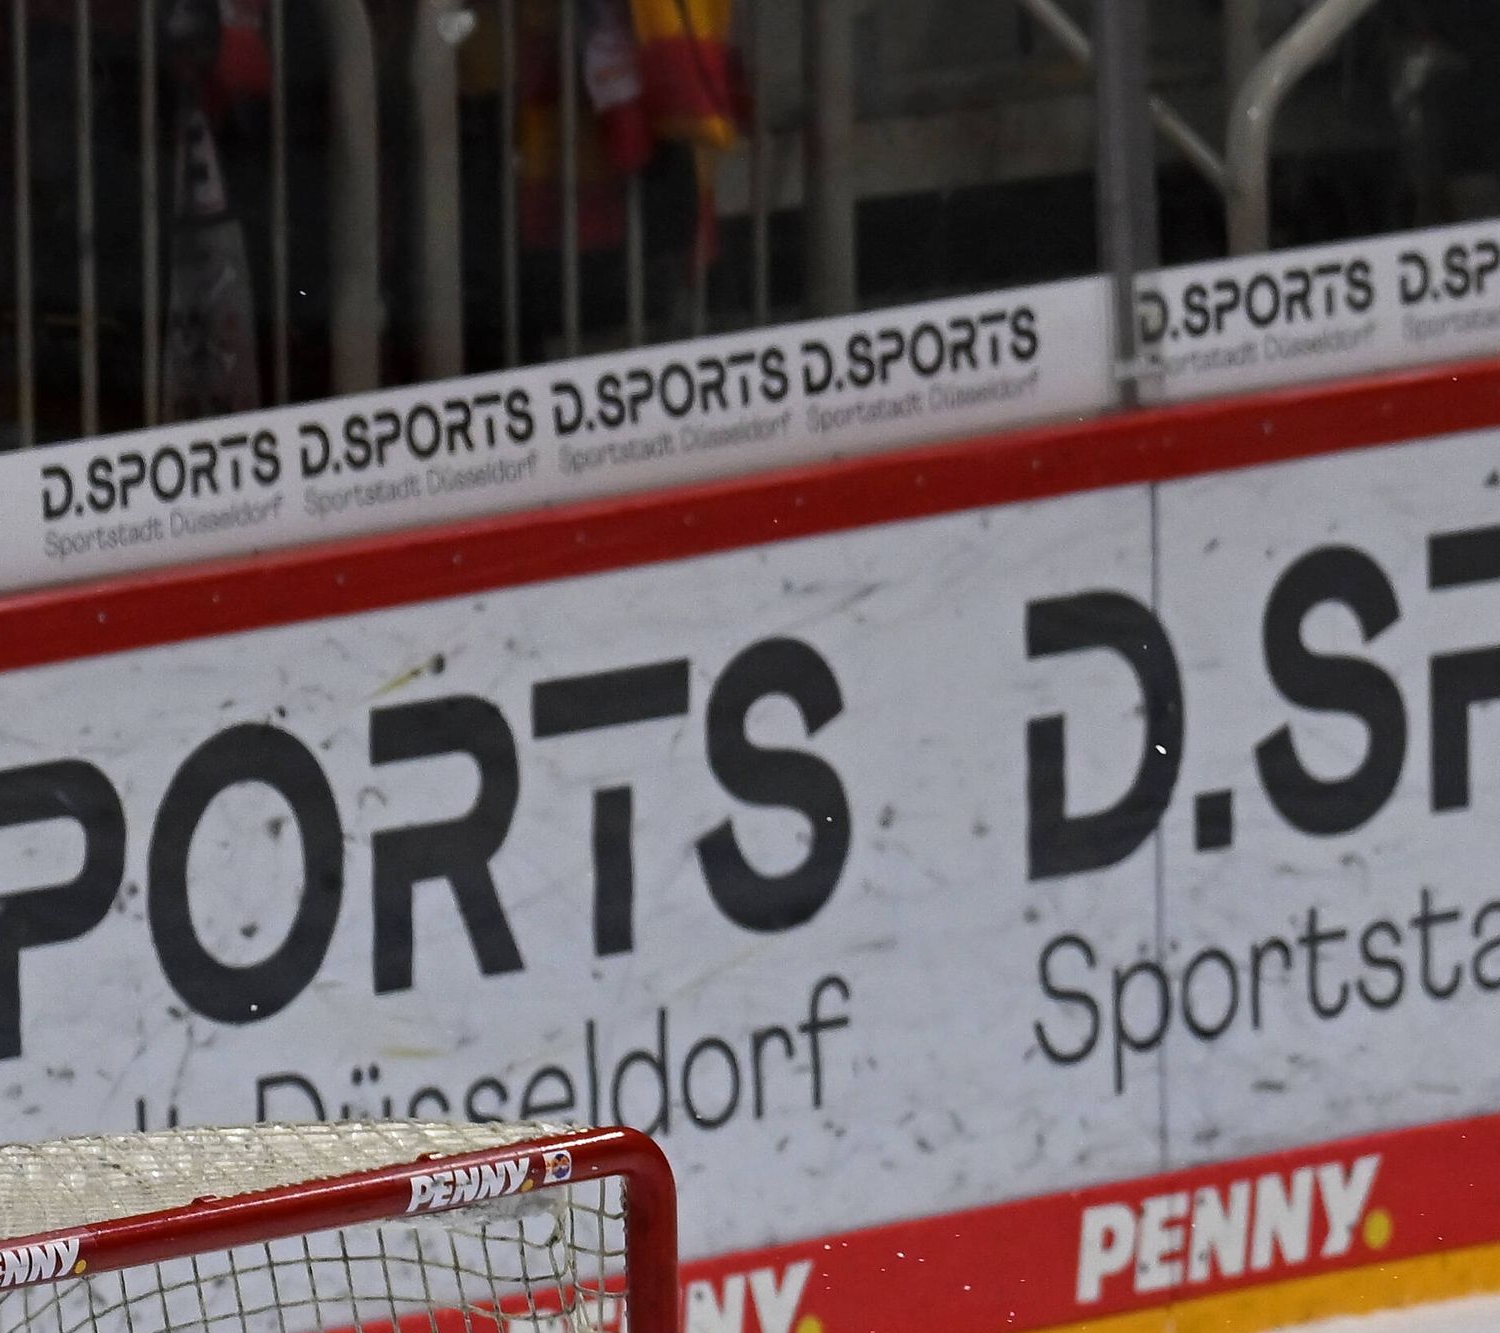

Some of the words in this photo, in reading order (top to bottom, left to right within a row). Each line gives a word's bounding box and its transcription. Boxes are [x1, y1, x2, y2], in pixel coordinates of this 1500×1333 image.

[1140, 259, 1373, 344] D.SPORTS
[42, 429, 280, 520] D.SPORTS
[301, 389, 534, 479] D.SPORTS
[552, 347, 790, 436] D.SPORTS
[802, 307, 1039, 395] D.SPORTS
[256, 976, 850, 1137] seldorf
